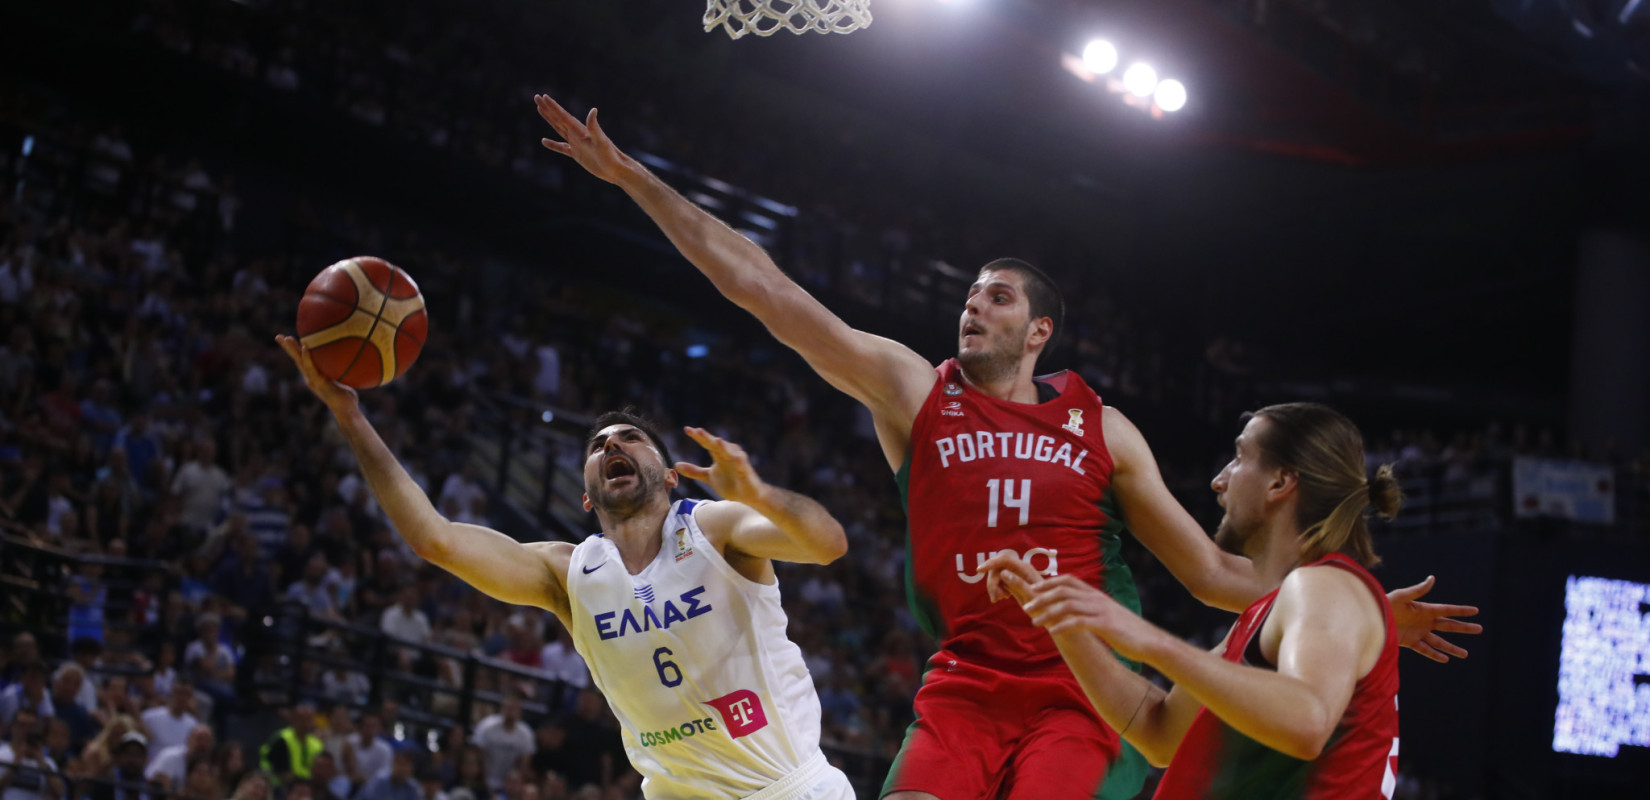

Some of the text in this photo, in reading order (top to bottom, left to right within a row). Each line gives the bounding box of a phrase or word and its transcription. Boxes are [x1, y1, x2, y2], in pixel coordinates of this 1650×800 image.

[936, 431, 1088, 475] PORTUGAL
[986, 479, 1031, 527] 14
[594, 585, 713, 640] ΕΛΛΑΣ
[653, 647, 683, 688] 6
[640, 697, 754, 747] COSMOTE T
